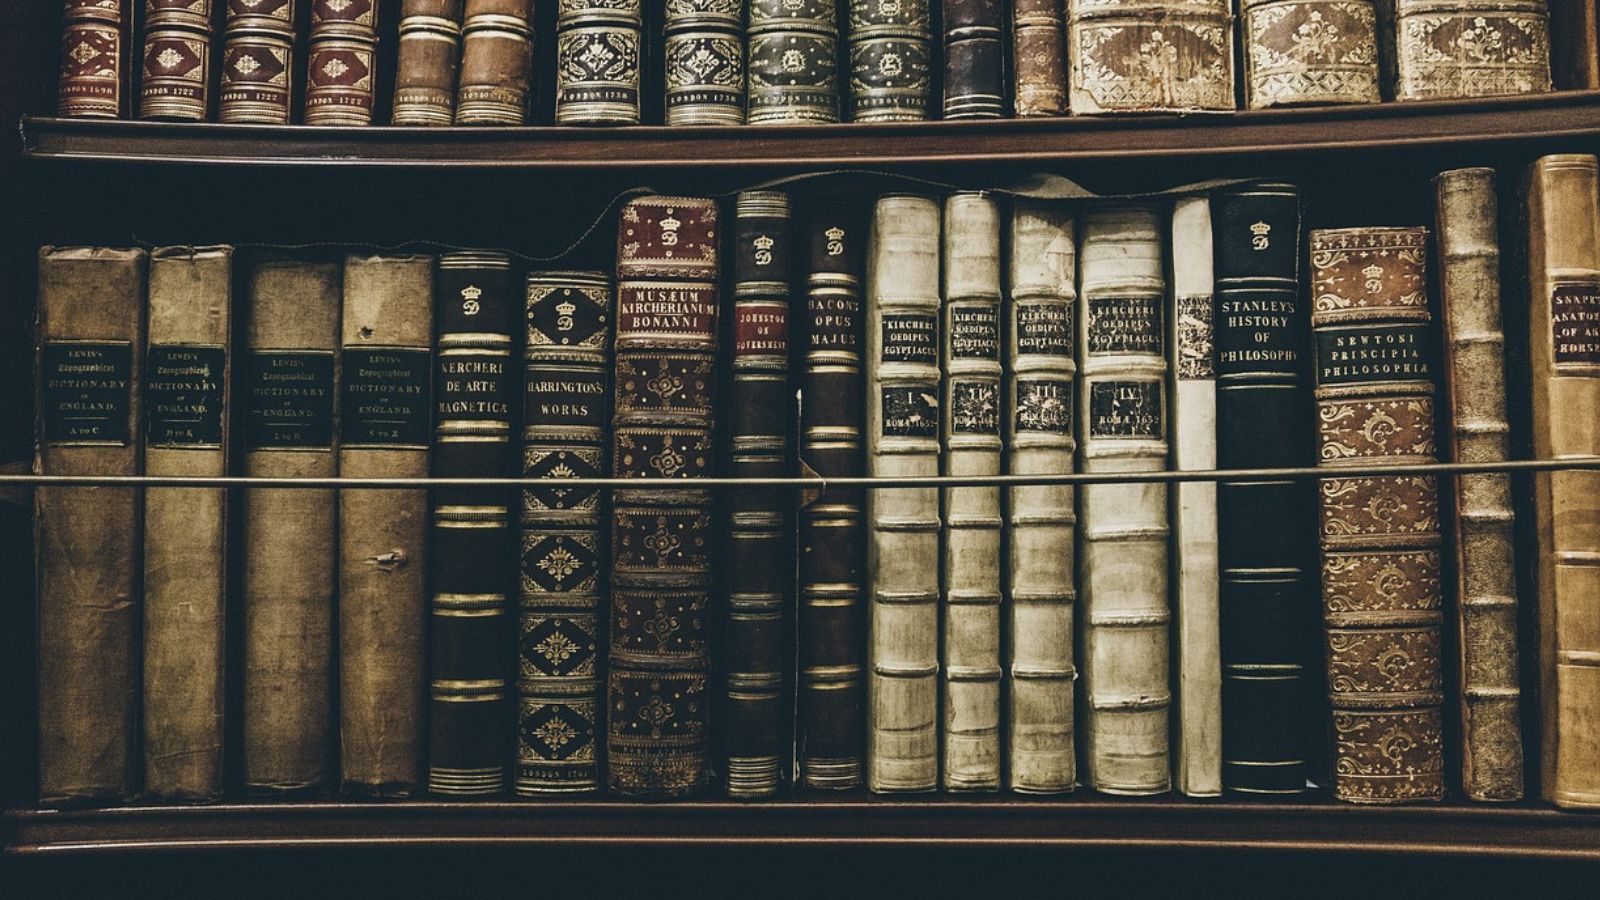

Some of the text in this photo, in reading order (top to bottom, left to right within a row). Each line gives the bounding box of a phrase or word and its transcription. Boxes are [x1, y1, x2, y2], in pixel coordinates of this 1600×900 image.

[256, 92, 278, 101] 1722
[340, 97, 363, 105] 1722
[563, 92, 602, 101] LONDON
[671, 94, 709, 104] LONDON
[857, 97, 900, 107] LONDON
[622, 303, 714, 315] KIRCHERIANUM
[632, 317, 698, 328] BONANNI
[815, 316, 851, 327] OPUS
[1228, 316, 1288, 328] HISTORY
[757, 326, 769, 335] ON
[1561, 327, 1578, 337] OF
[810, 333, 857, 345] MAJUS
[890, 333, 931, 342] OEDIPUS
[1254, 331, 1270, 343] OF
[1336, 334, 1414, 347] NEWTONI
[1331, 349, 1419, 361] PRINCIPIA
[48, 380, 126, 389] DICTIONARY
[149, 382, 217, 391] DICTIONARY
[349, 385, 422, 394] DICTIONARY
[447, 381, 496, 392] DE ARTE
[254, 387, 323, 396] DICTIONARY
[541, 404, 589, 417] WORKS
[92, 426, 99, 435] C
